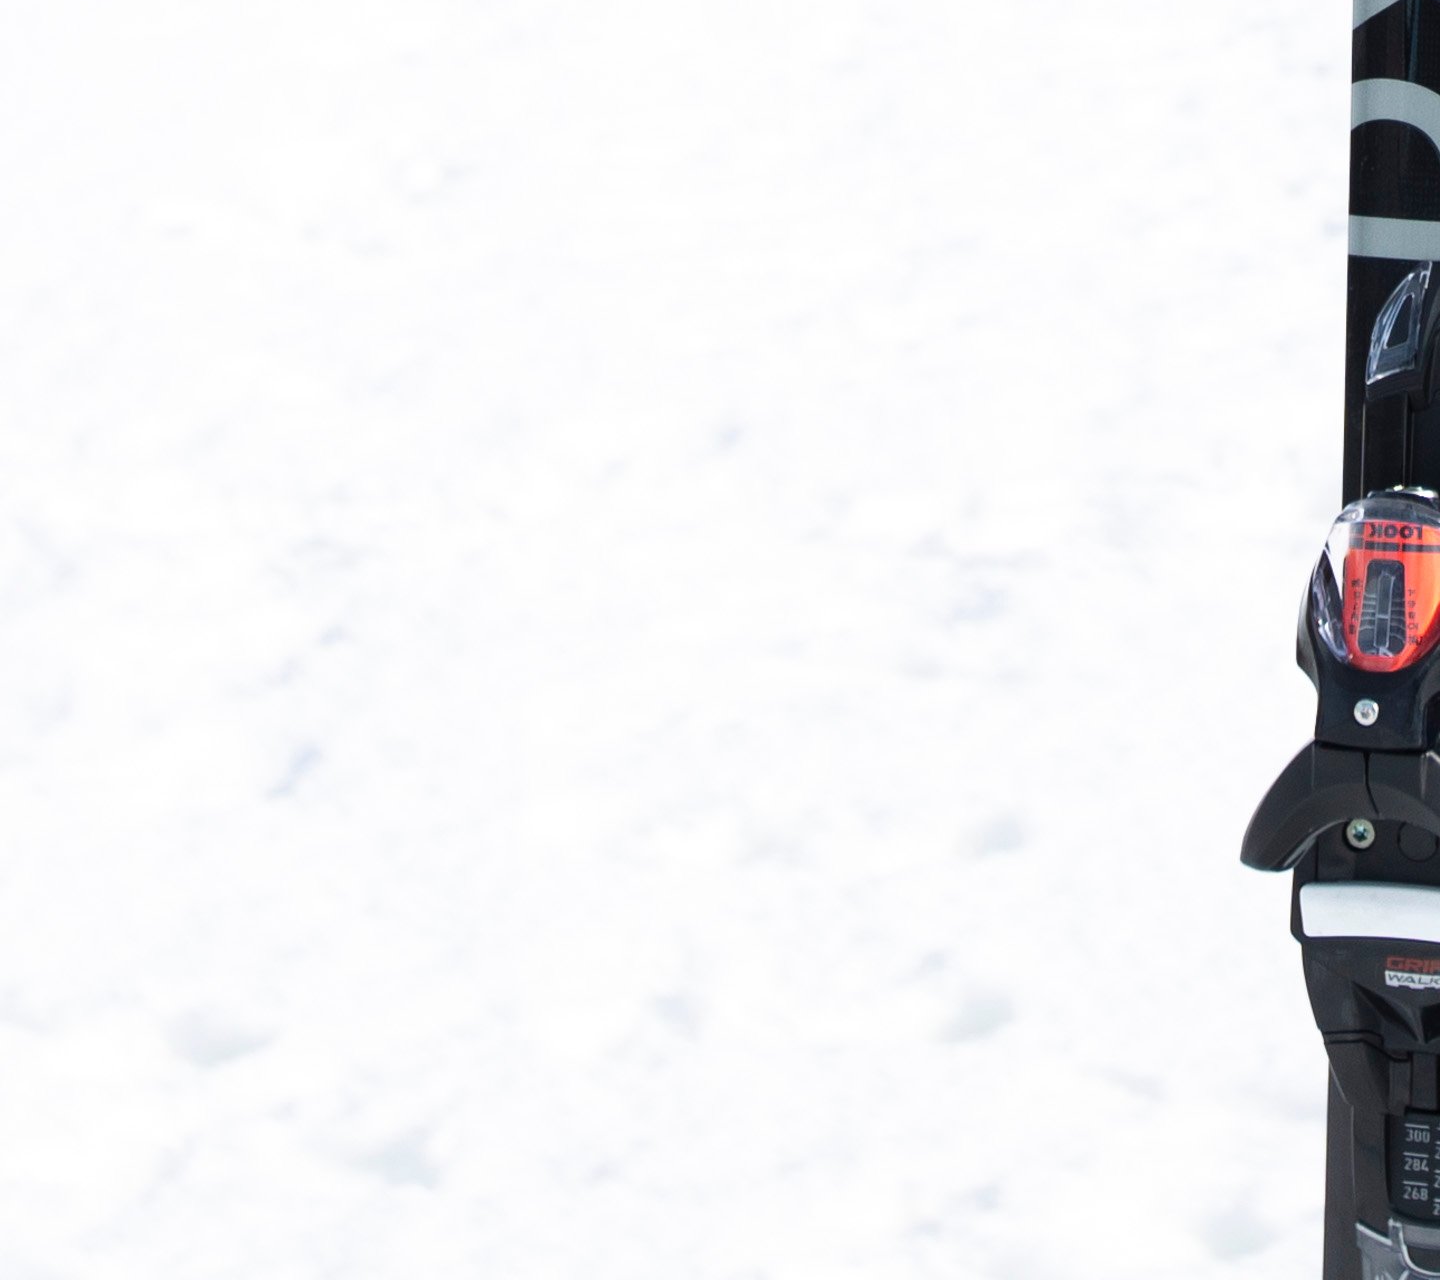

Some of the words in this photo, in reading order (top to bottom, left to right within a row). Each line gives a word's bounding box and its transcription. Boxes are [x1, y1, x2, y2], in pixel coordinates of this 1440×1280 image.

[1368, 524, 1423, 540] LOOK
[1405, 1129, 1431, 1143] 300
[1404, 1158, 1429, 1172] 284
[1403, 1187, 1429, 1201] 268
